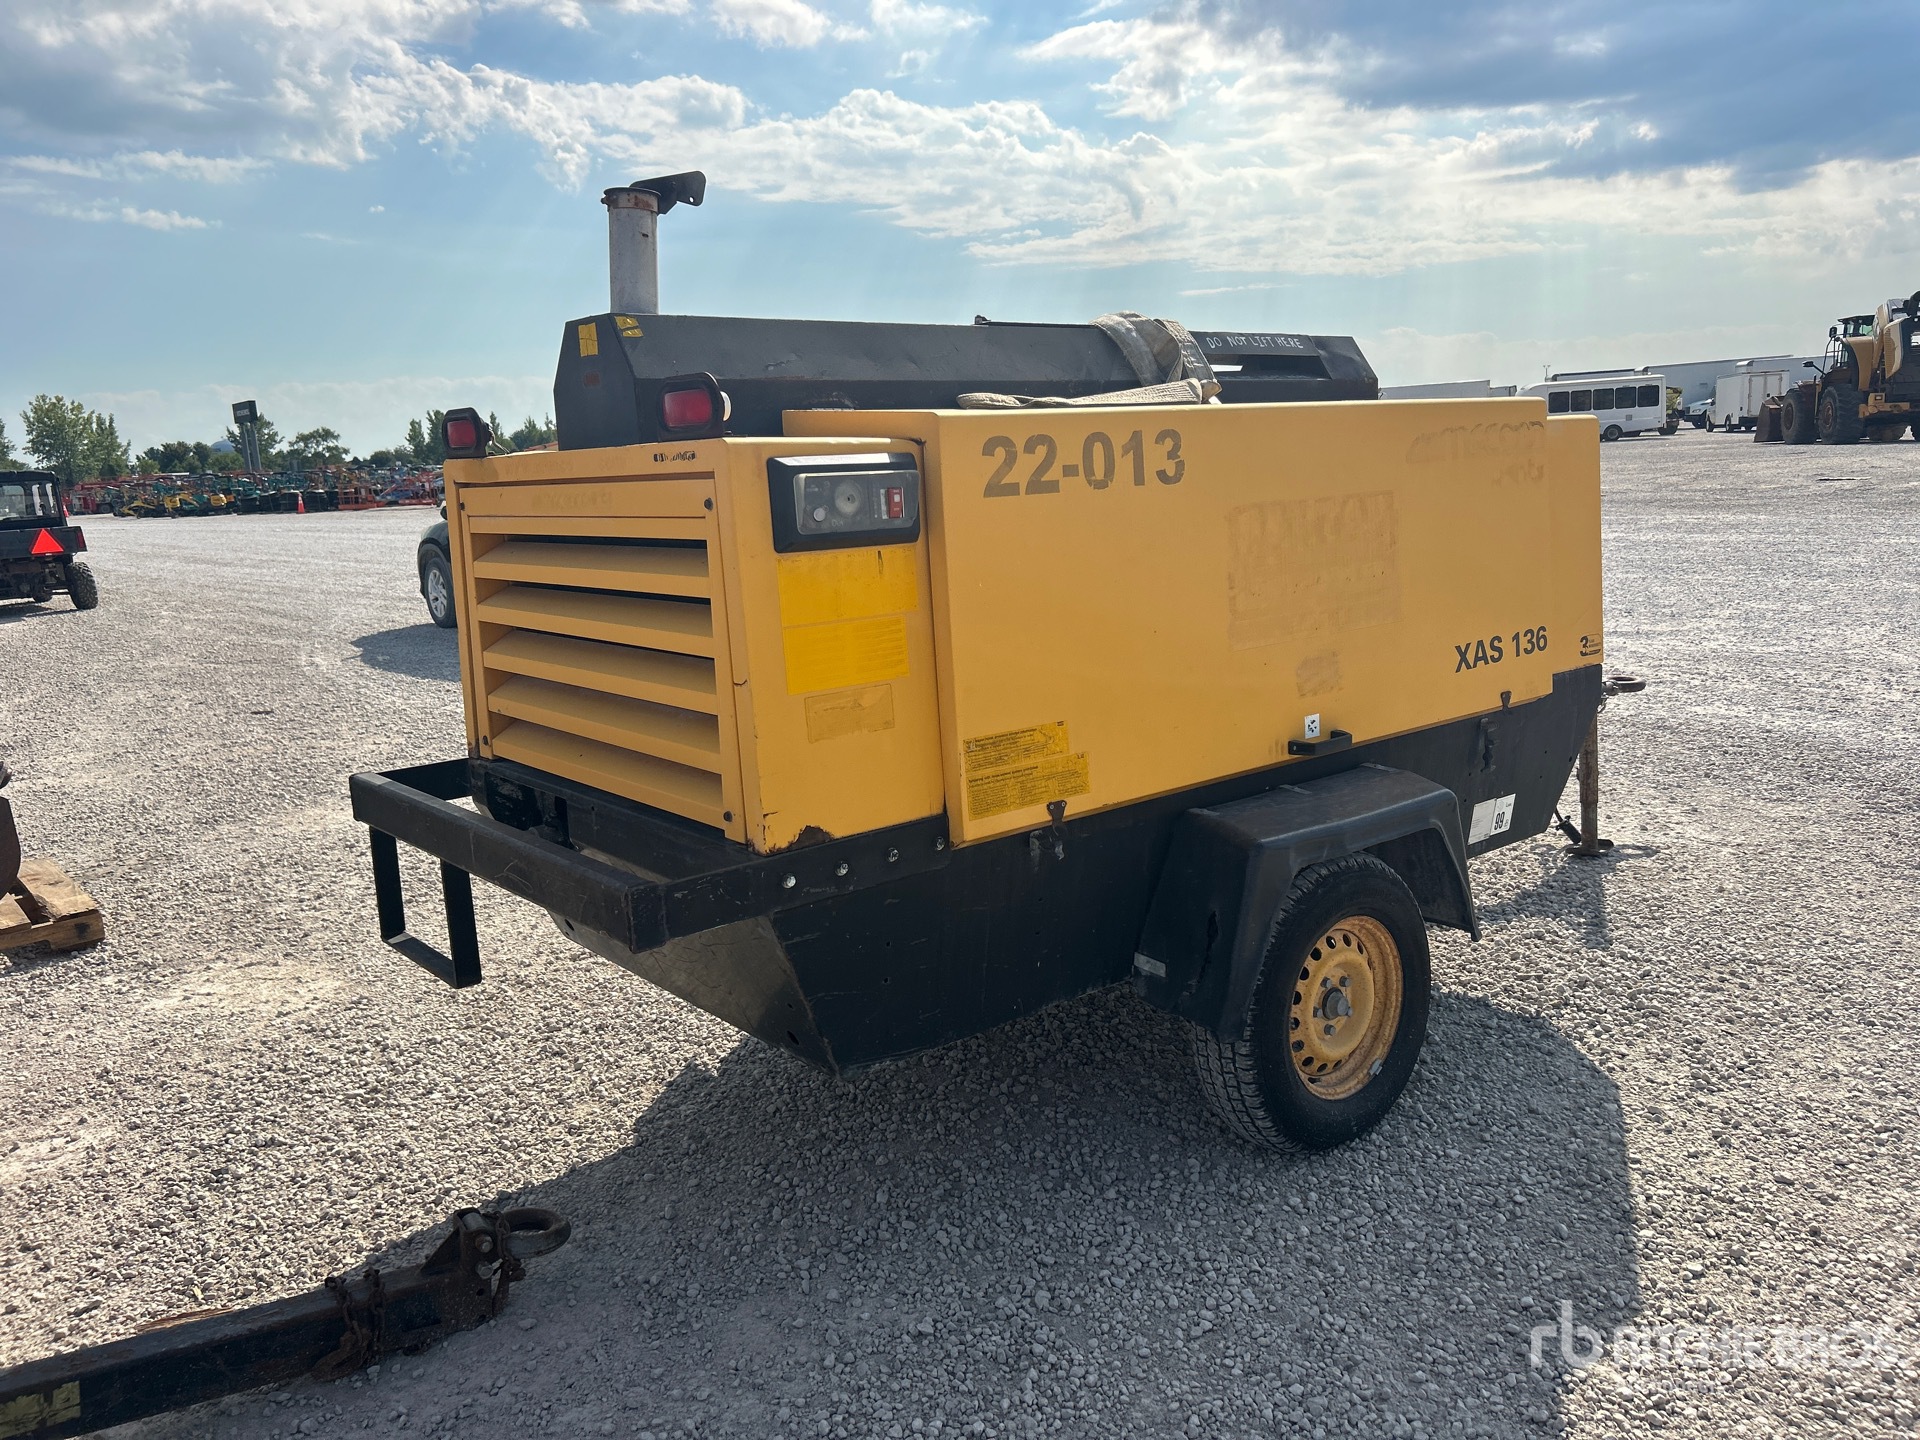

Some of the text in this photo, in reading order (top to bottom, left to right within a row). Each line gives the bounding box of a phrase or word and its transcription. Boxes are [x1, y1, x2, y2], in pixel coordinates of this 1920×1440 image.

[1206, 336, 1304, 349] DO NOT LIFT HERE
[982, 429, 1186, 498] 22-013
[1454, 625, 1548, 674] XAS 136
[1494, 811, 1506, 831] 99
